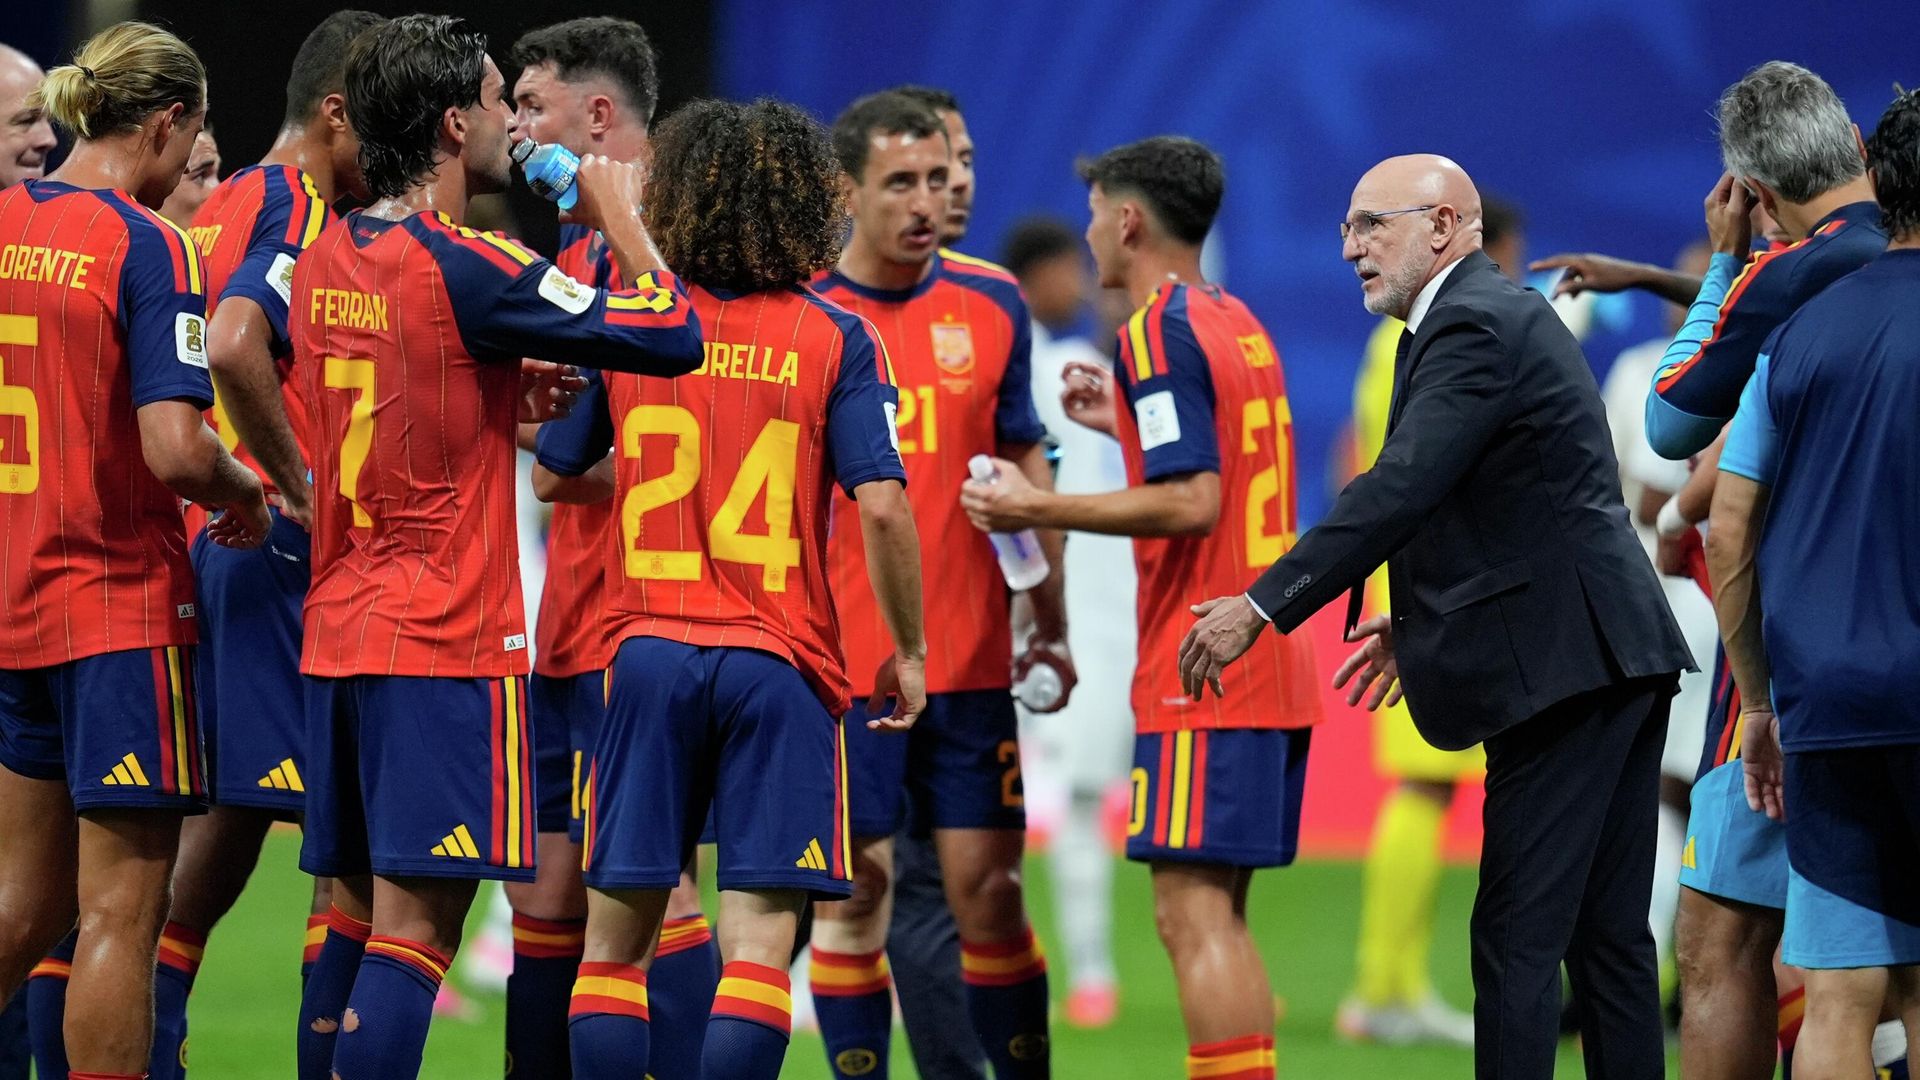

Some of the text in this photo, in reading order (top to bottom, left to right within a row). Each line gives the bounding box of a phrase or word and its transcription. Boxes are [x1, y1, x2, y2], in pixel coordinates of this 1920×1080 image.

[310, 288, 388, 331] FERRAN
[324, 357, 376, 529] 7
[896, 384, 938, 455] 21
[621, 404, 801, 593] 24
